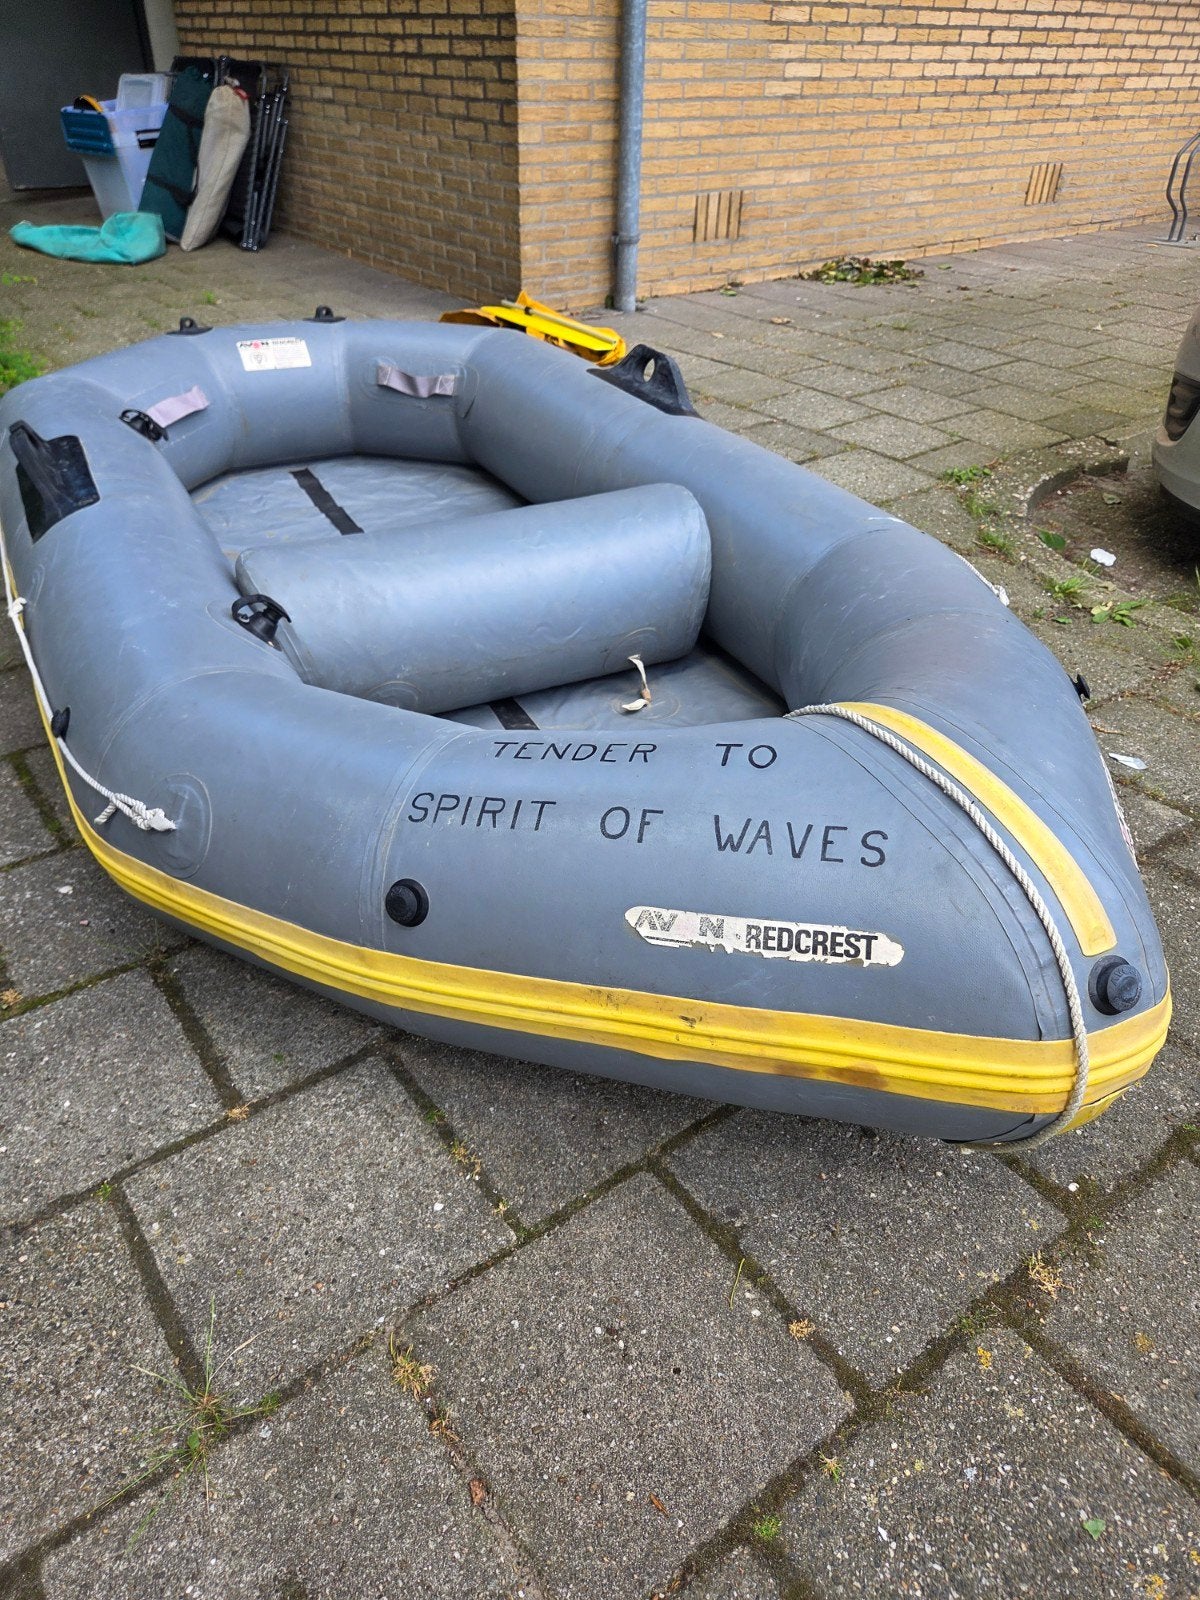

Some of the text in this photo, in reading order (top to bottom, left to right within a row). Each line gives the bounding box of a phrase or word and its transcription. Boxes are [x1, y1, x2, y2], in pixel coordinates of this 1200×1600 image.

[494, 741, 778, 769] TENDER TO
[408, 792, 889, 868] SPIRIT OF WAVES
[635, 909, 879, 961] AVN REDCREST
